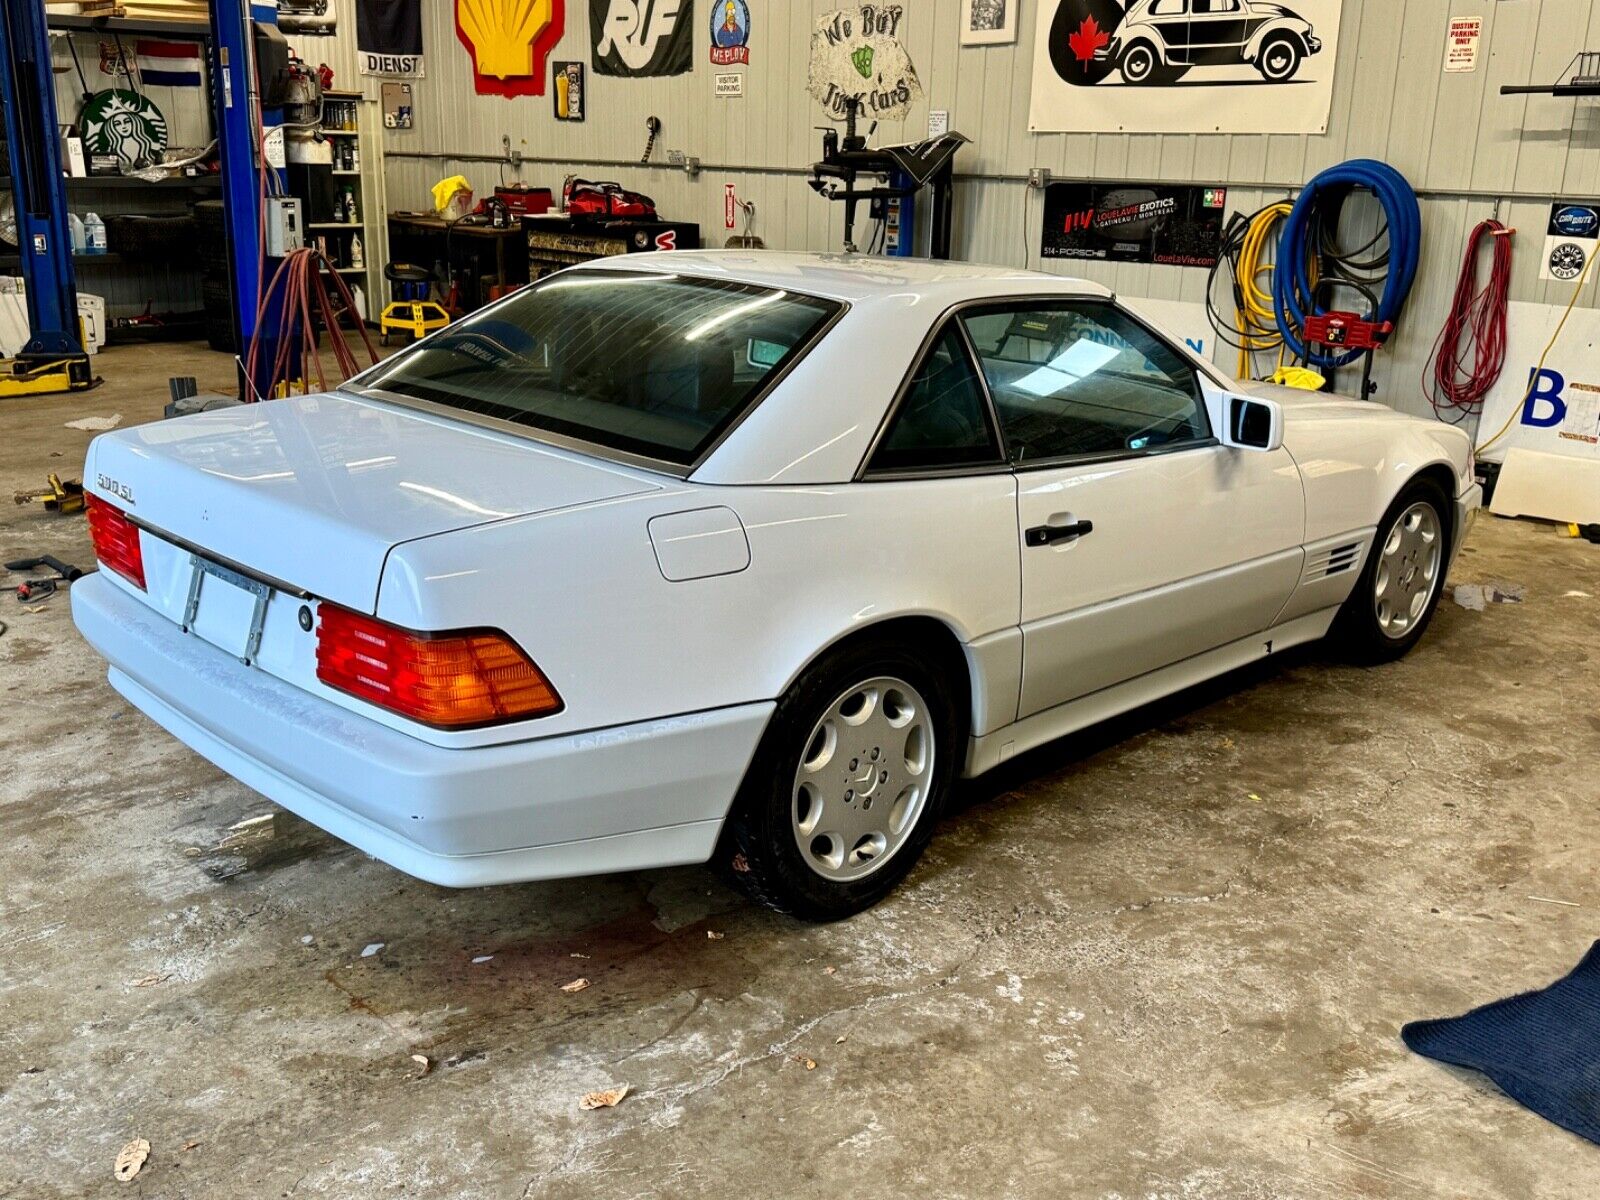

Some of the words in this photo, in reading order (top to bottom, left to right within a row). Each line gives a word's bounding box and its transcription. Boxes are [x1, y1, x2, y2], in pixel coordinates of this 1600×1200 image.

[597, 0, 681, 69] RUF
[367, 55, 418, 73] DIENST
[716, 84, 740, 92] PARKING
[1139, 197, 1174, 213] EXOTICS
[1099, 215, 1131, 228] GATINEAU
[559, 234, 597, 248] Snap-on
[1552, 245, 1583, 262] CHEMICAL
[1554, 267, 1577, 277] GUYS
